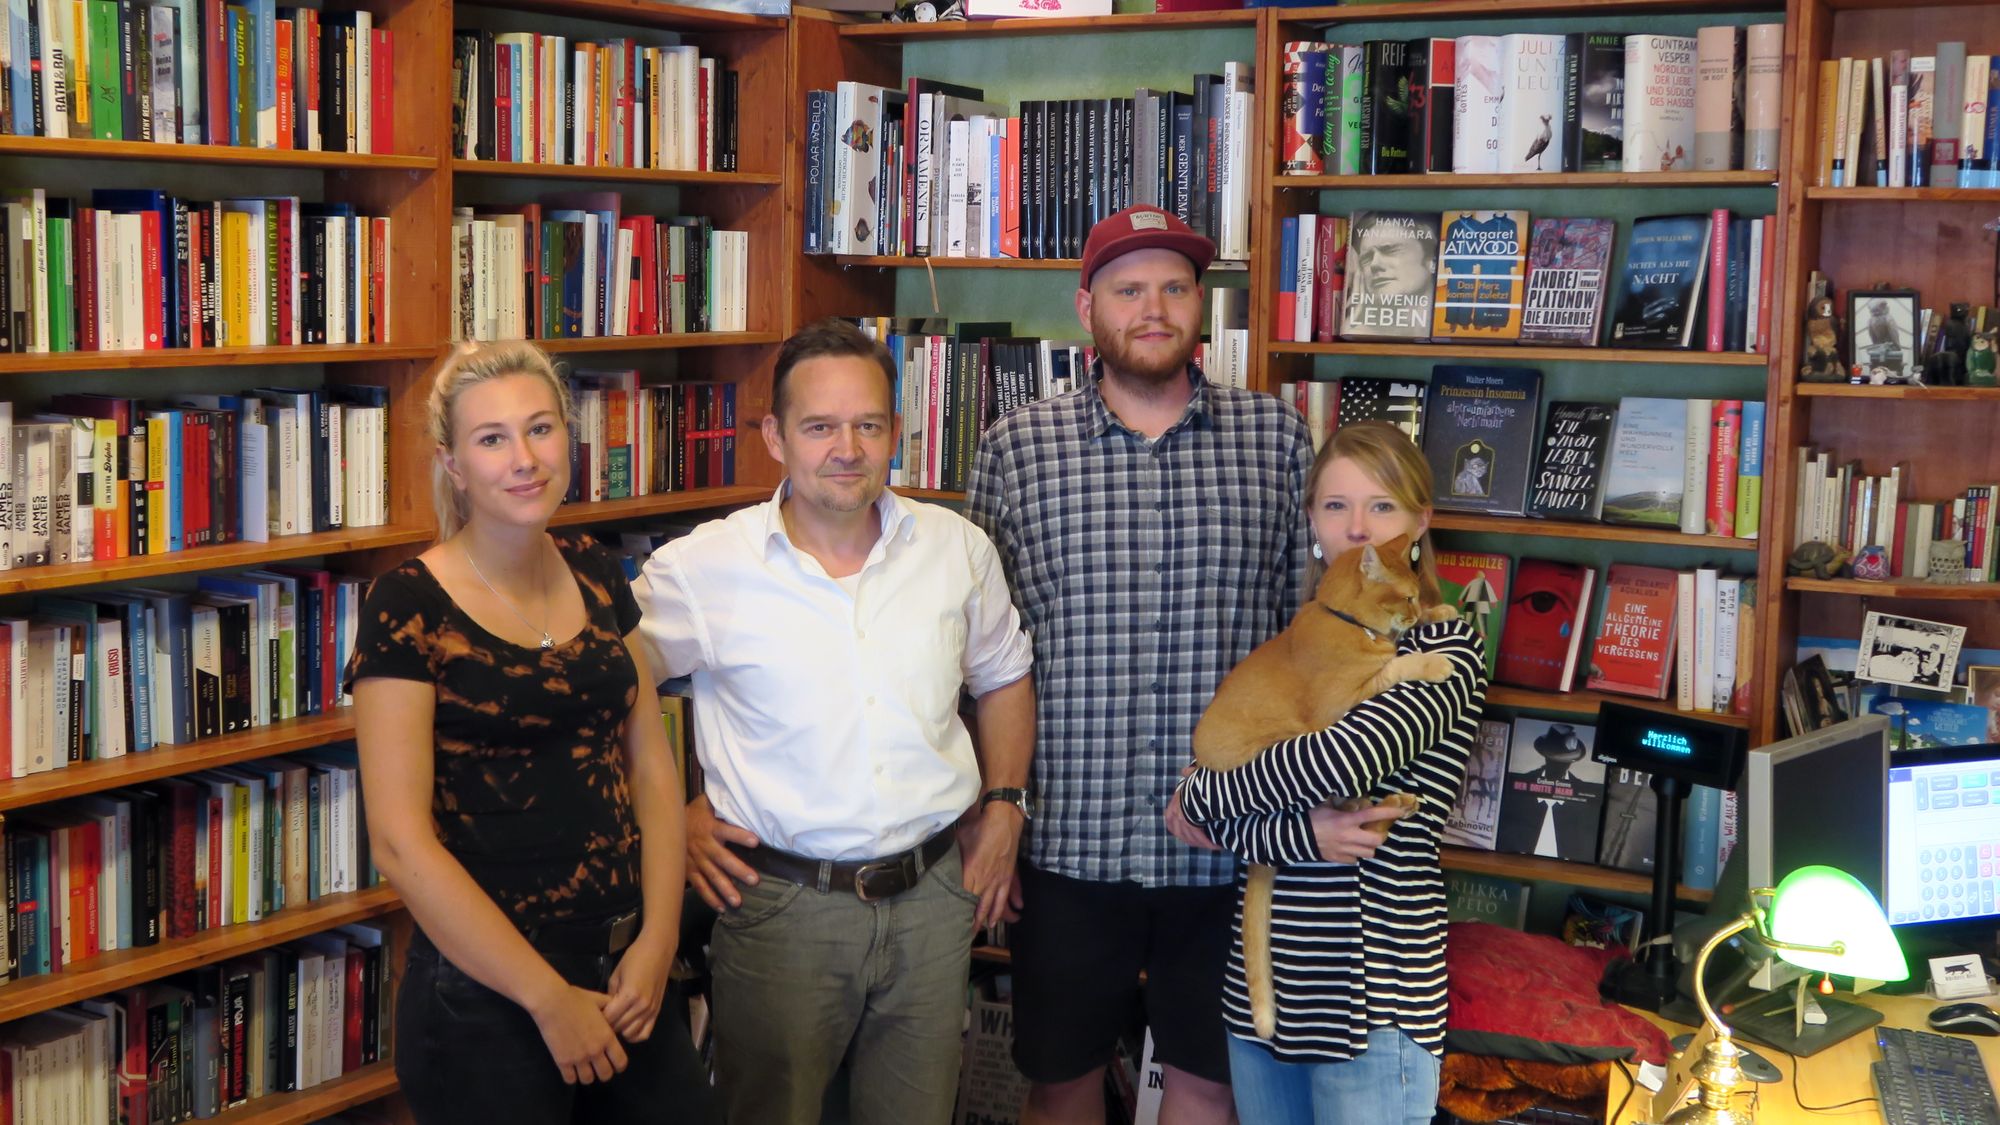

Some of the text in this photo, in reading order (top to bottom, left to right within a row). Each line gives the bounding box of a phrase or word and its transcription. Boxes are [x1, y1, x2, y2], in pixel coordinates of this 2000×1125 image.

[1518, 40, 1553, 55] JULI
[1588, 36, 1620, 51] ANNIE
[1651, 38, 1698, 51] GUNTRAM
[278, 47, 290, 77] 89/90
[1382, 42, 1407, 66] REIF
[1658, 51, 1691, 64] VESPER
[1325, 53, 1341, 87] Wray
[1653, 63, 1696, 76] NÖRDLICH
[52, 48, 67, 113] RATH & RAI
[1654, 75, 1692, 86] DER LIEBE
[1460, 83, 1468, 113] GOTTES
[1645, 85, 1698, 98] UND SÜDLICH
[278, 91, 287, 131] PETER RICHTER
[1649, 97, 1695, 109] DES HASSES
[141, 94, 151, 141] KATHY REICHS
[810, 99, 822, 184] POLAR WORLD
[1073, 112, 1082, 161] Künstlerporträts
[1087, 110, 1096, 174] HARALD HAUSWALD
[1178, 134, 1187, 150] DER
[1324, 121, 1336, 156] John
[1049, 111, 1057, 198] GUNDULA SCHULZE ELDOWY
[1207, 117, 1217, 193] DEUTSCHLAND
[1222, 121, 1231, 185] RHEINLANDSCHAFTEN
[917, 119, 931, 222] ORNAMENTS
[991, 152, 999, 179] VOGUE
[1021, 150, 1029, 205] DAS PURE LEBEN
[1034, 153, 1042, 205] DAS PURE LEBEN
[932, 167, 942, 217] Eve Arnold
[1063, 187, 1071, 205] Roger
[1073, 182, 1082, 200] Roger
[1375, 217, 1417, 229] HANYA
[267, 204, 278, 272] FOLLOWER
[1356, 228, 1434, 242] YANAGIHARA
[1452, 228, 1515, 243] Margaret
[1656, 234, 1694, 244] WILLIAMS
[1444, 241, 1520, 256] ATWOOD
[1628, 259, 1692, 270] NICHTS ALS DIE
[1457, 281, 1500, 293] Das Herz
[1531, 269, 1578, 290] ANDREJ
[1632, 273, 1681, 286] NACHT
[1728, 259, 1737, 301] ANNA KIM
[1350, 292, 1429, 307] EIN WENIG
[1527, 289, 1596, 310] PLATONOW
[1350, 307, 1428, 328] LEBEN
[1525, 310, 1592, 327] DIE BAUGRUBE
[932, 342, 940, 364] LEBEN
[931, 363, 939, 384] LAND,
[995, 365, 1003, 385] (SAALE)
[1009, 371, 1018, 395] CHEMNITZ
[1018, 373, 1026, 392] LEIPZIG
[1466, 375, 1504, 386] Walter Moers
[1002, 372, 1012, 410] PLACES LEIPZIG
[1440, 385, 1527, 400] Prinzessin Insomnia
[1456, 414, 1504, 429] Nachtmahr
[1557, 420, 1581, 435] DIE
[103, 441, 114, 474] Delpha
[1544, 449, 1595, 466] LEBEN
[1619, 444, 1675, 453] WUNDERVOLLE
[1743, 449, 1751, 462] WELT
[1535, 471, 1592, 491] SAMUEL
[1716, 463, 1726, 482] BANK
[1534, 490, 1591, 511] HAWLEY
[33, 496, 41, 536] JAMES
[40, 495, 49, 537] SALTER
[55, 494, 64, 535] JAMES
[62, 494, 71, 536] SALTER
[1458, 556, 1504, 571] SCHULZE
[1619, 587, 1660, 598] AGUALUSA
[1624, 602, 1648, 616] EINE
[1606, 612, 1663, 628] ALLGEMEINE
[1604, 622, 1661, 641] THEORIE
[1619, 636, 1640, 648] DES
[106, 648, 119, 677] KRUSO
[138, 649, 146, 676] ALBRECHT
[1598, 643, 1660, 662] VERGESSENS
[138, 685, 149, 744] DIE TRUNKENE FAHRT
[1641, 738, 1692, 755] willkommen
[1648, 729, 1688, 747] Herzlich
[1513, 780, 1574, 797] DER DRITTE MANN
[1536, 777, 1572, 789] Graham Greene
[1725, 804, 1736, 821] ALLE
[1724, 820, 1735, 837] WIE
[1450, 879, 1509, 902] RIIKKA
[1456, 896, 1498, 915] PELO
[88, 909, 96, 935] Andrzej
[288, 971, 296, 1010] DER VOYEUR
[287, 1014, 295, 1048] GAY TALESE
[233, 1023, 244, 1097] PSYCHOPATHEN
[1148, 1070, 1164, 1090] IN
